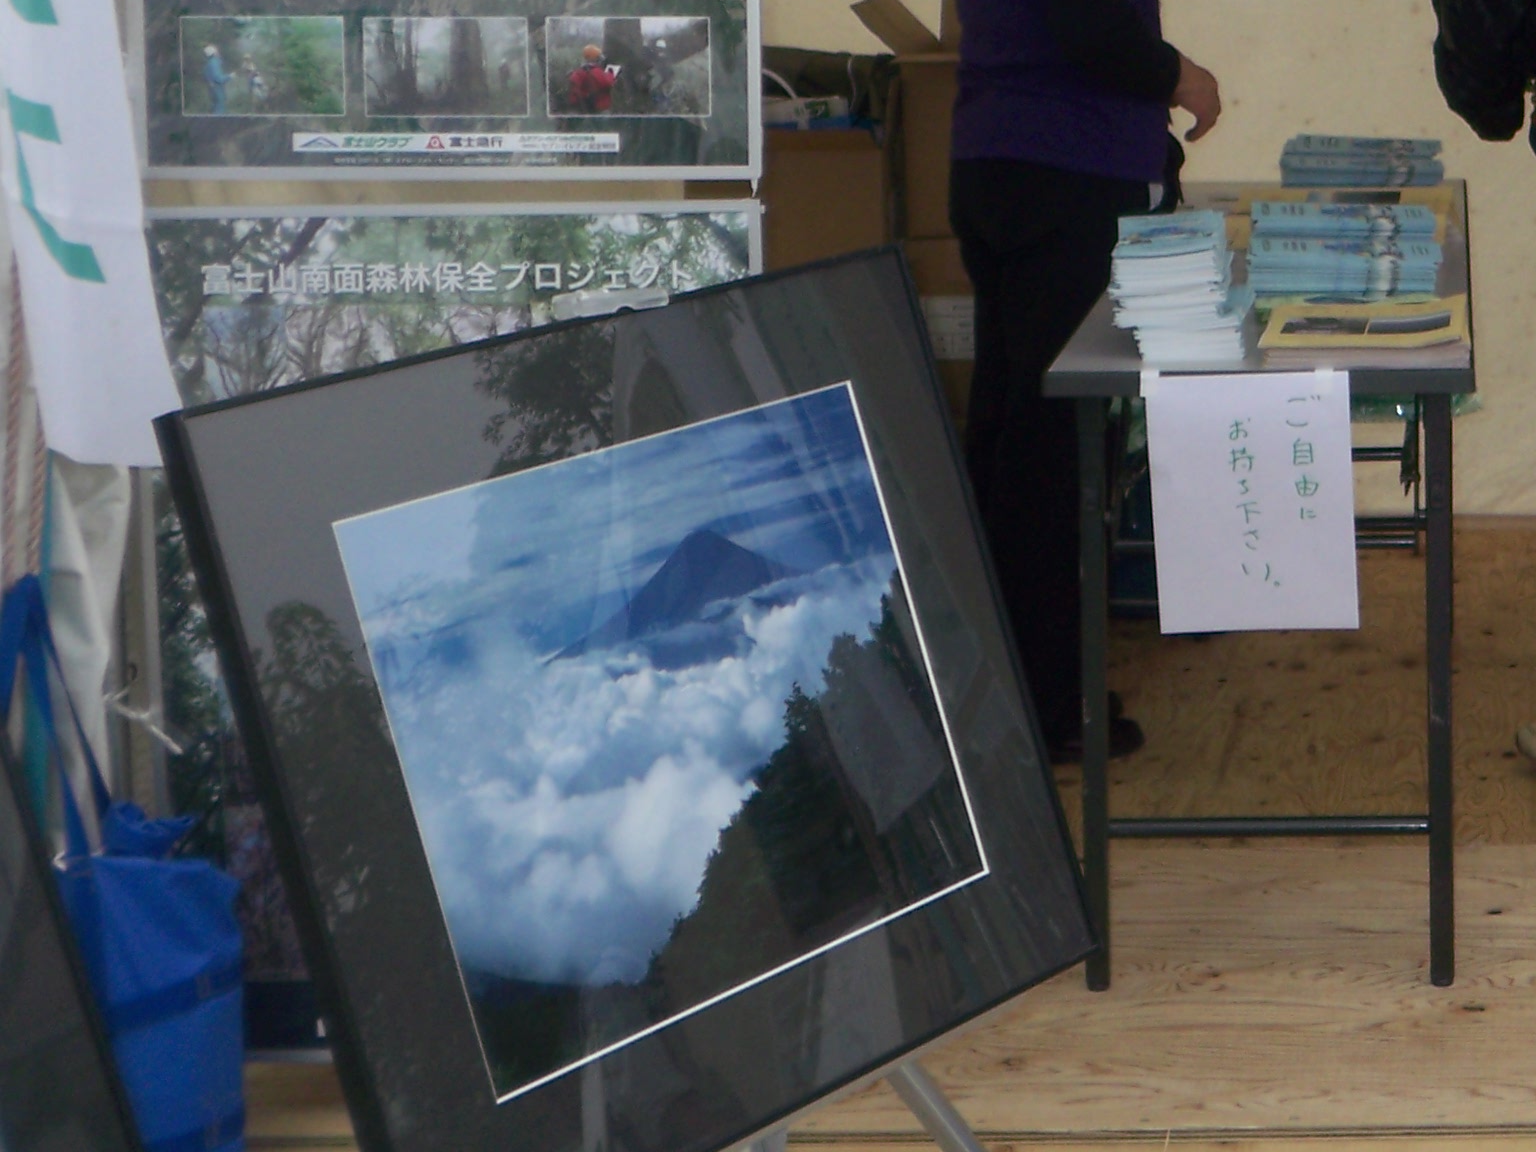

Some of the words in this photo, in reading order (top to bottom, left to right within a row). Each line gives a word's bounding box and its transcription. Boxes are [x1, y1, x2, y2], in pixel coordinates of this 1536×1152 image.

[342, 136, 412, 148] 富士山クラブ
[201, 262, 694, 295] 富士山南面森林保全プロジェクト
[1286, 395, 1320, 520] ご自由に
